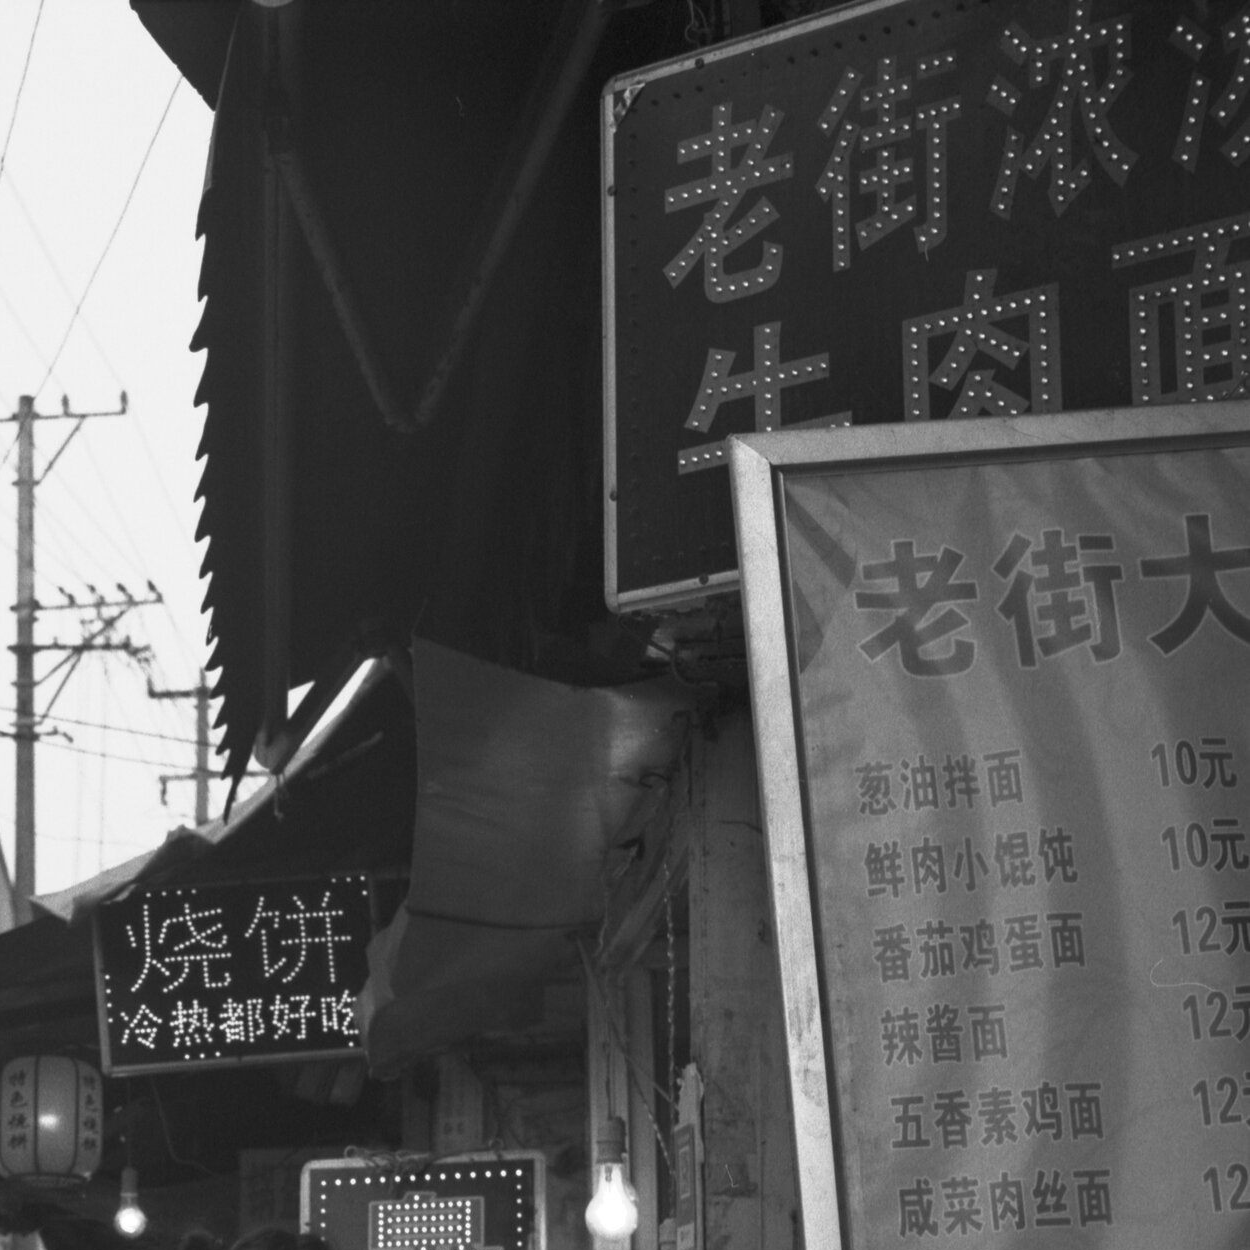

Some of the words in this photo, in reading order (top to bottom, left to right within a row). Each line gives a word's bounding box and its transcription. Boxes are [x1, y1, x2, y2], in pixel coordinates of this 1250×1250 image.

[677, 212, 1250, 475] 牛肉面
[854, 513, 1250, 678] 老街大
[855, 749, 1024, 816] 葱油拌面
[1151, 738, 1238, 789] 10元
[864, 827, 1078, 898] 鲜肉小馄饨
[1161, 819, 1250, 871] 10元
[125, 890, 351, 993] 烧饼
[873, 912, 1086, 983] 番茄鸡蛋面
[120, 989, 359, 1049] 冷热都好吃
[881, 1003, 1008, 1066] 辣酱面
[891, 1082, 1104, 1149] 五香素鸡面
[899, 1169, 1113, 1237] 咸菜肉丝面
